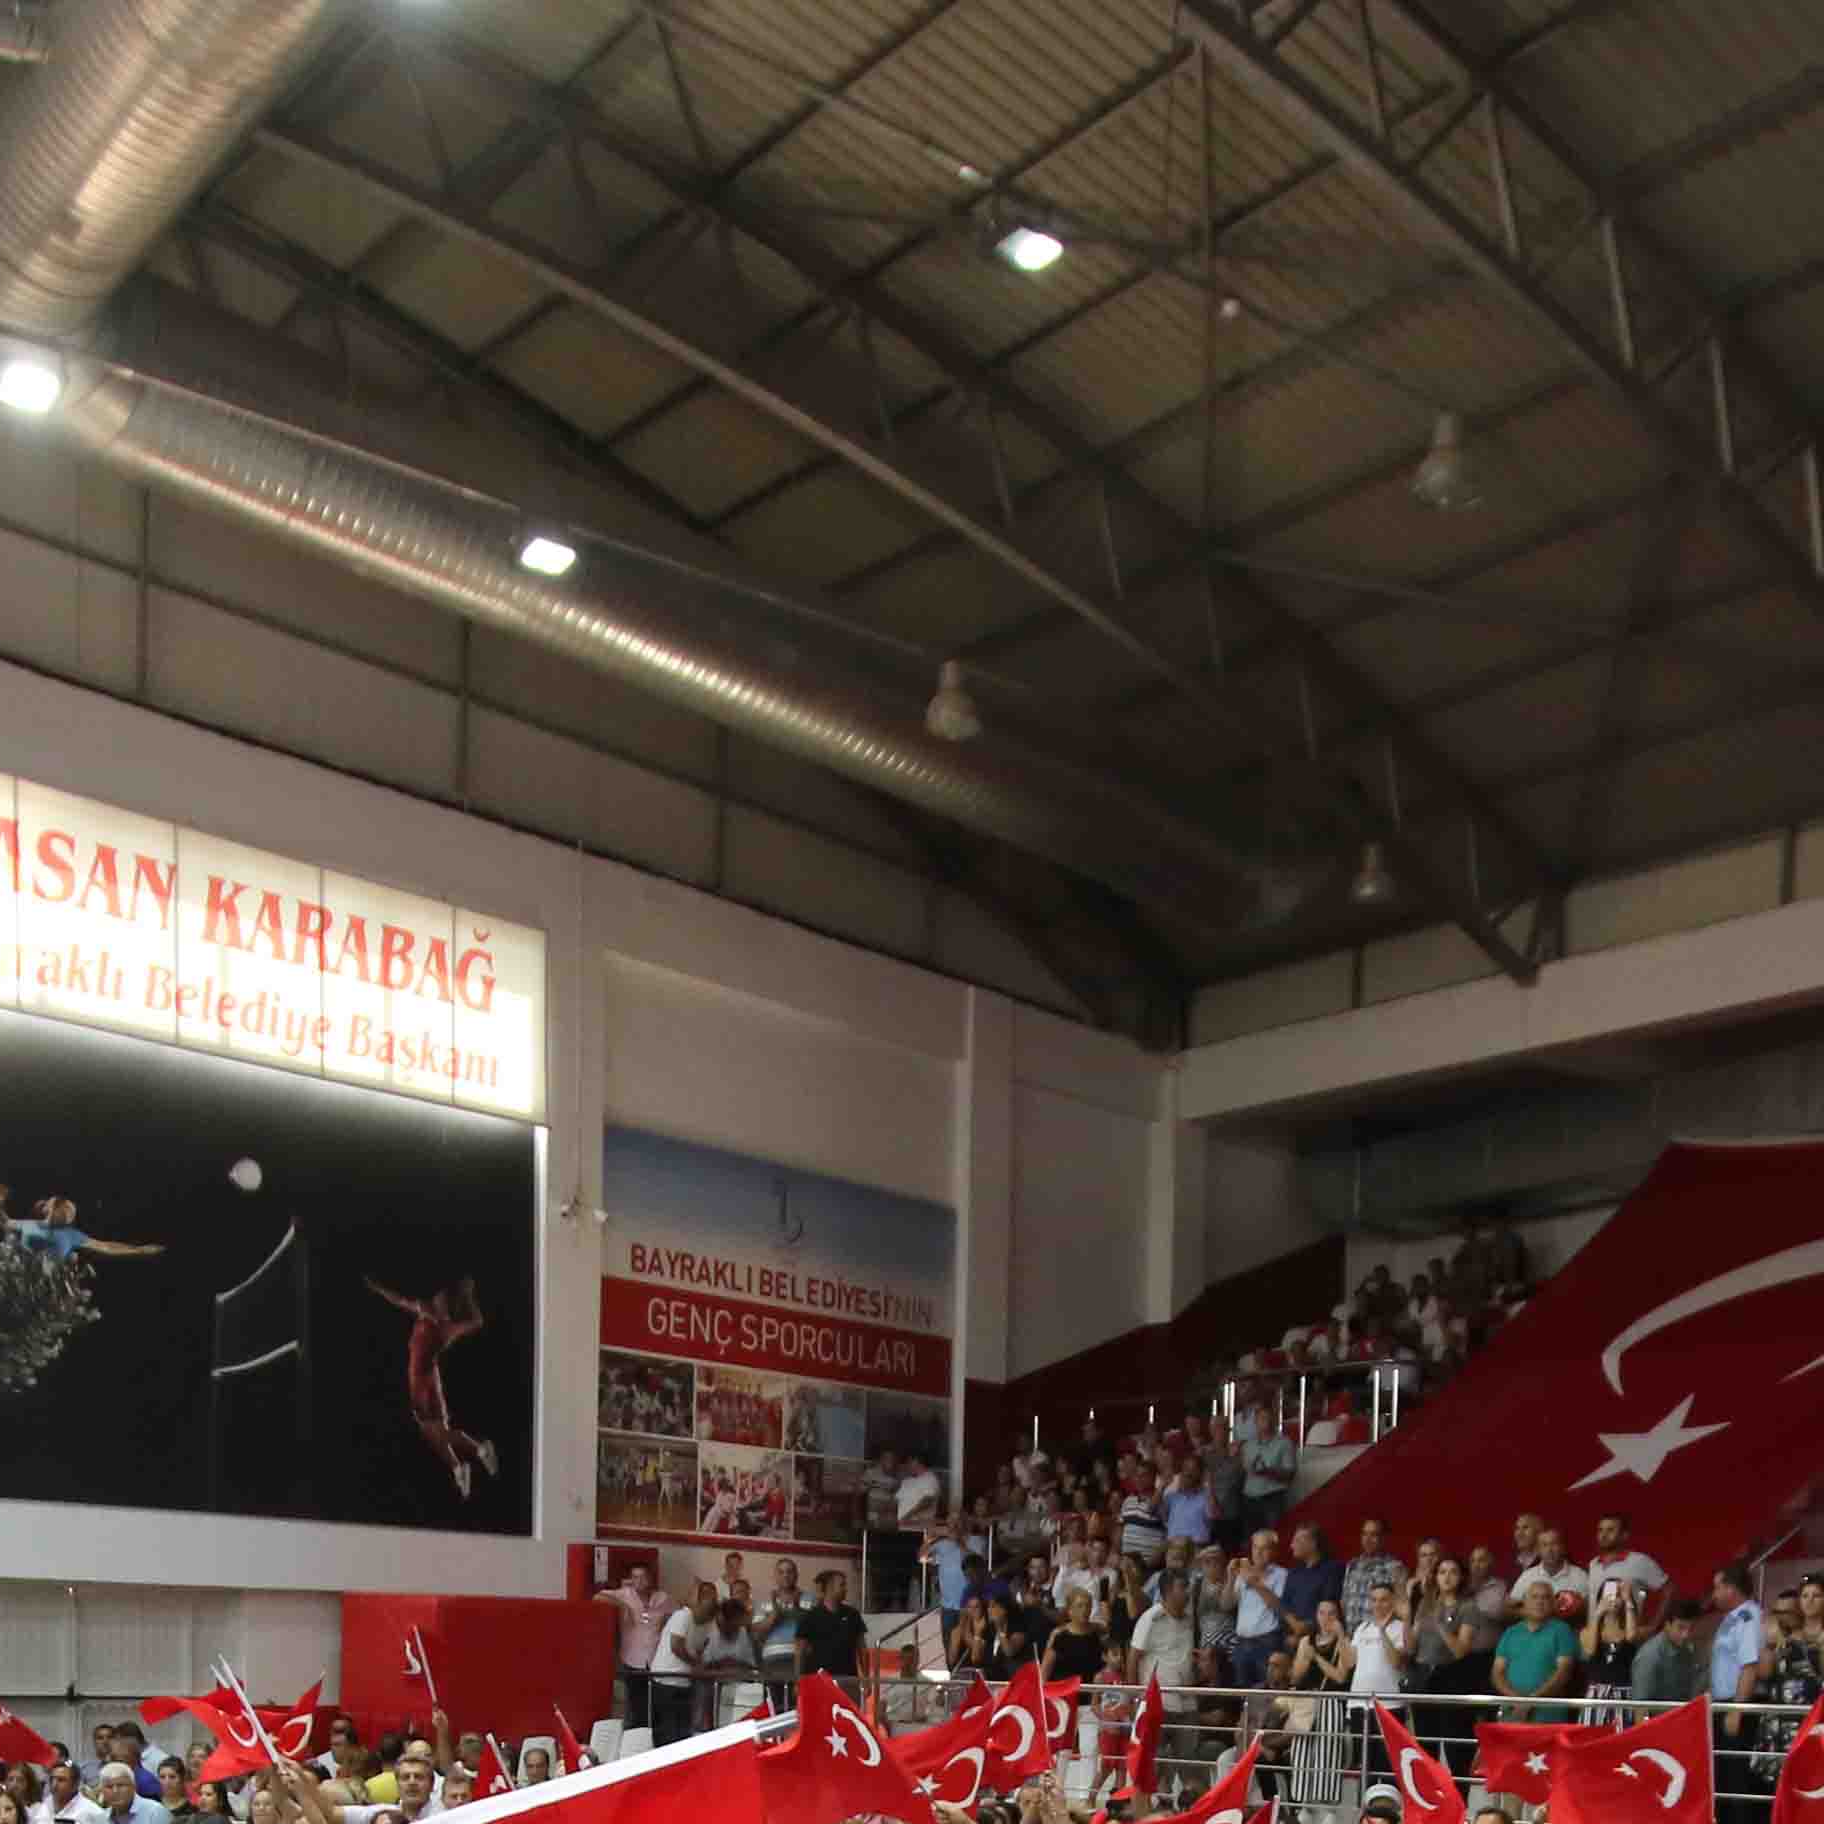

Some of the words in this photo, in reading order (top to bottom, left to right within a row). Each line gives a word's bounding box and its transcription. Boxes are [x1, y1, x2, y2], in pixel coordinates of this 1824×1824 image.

[200, 874, 498, 1014] KARABAĞ
[143, 962, 333, 1059] Belediye
[347, 1012, 499, 1089] Başkanı
[630, 1242, 753, 1295] BAYRAKLI
[647, 1296, 731, 1357] GENÇ
[741, 1313, 916, 1377] SPORCULARI
